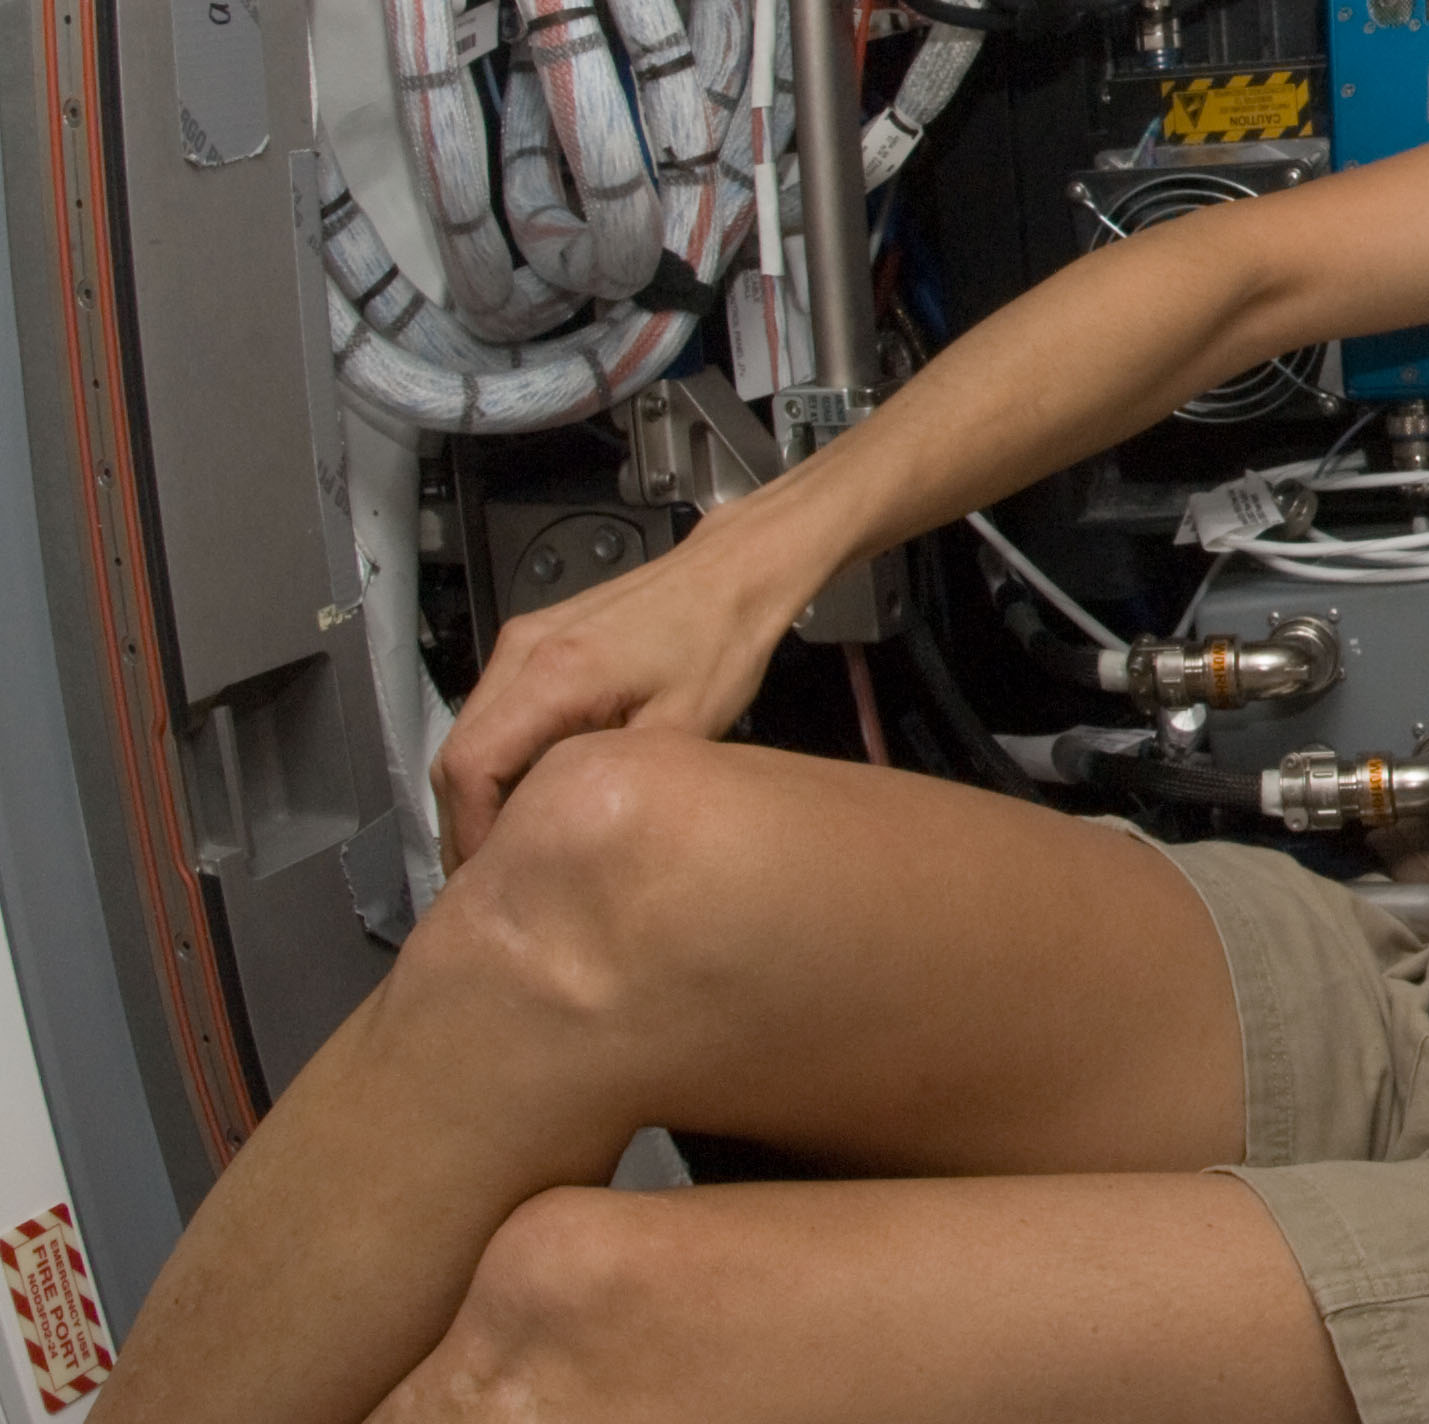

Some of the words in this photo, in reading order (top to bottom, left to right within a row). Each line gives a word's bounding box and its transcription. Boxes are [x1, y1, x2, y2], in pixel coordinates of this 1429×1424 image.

[1229, 113, 1280, 126] CAUTION
[32, 1246, 59, 1303] FIRE
[54, 1306, 81, 1371] PORT
[50, 1240, 83, 1331] EMERGENCY
[77, 1324, 91, 1361] USE
